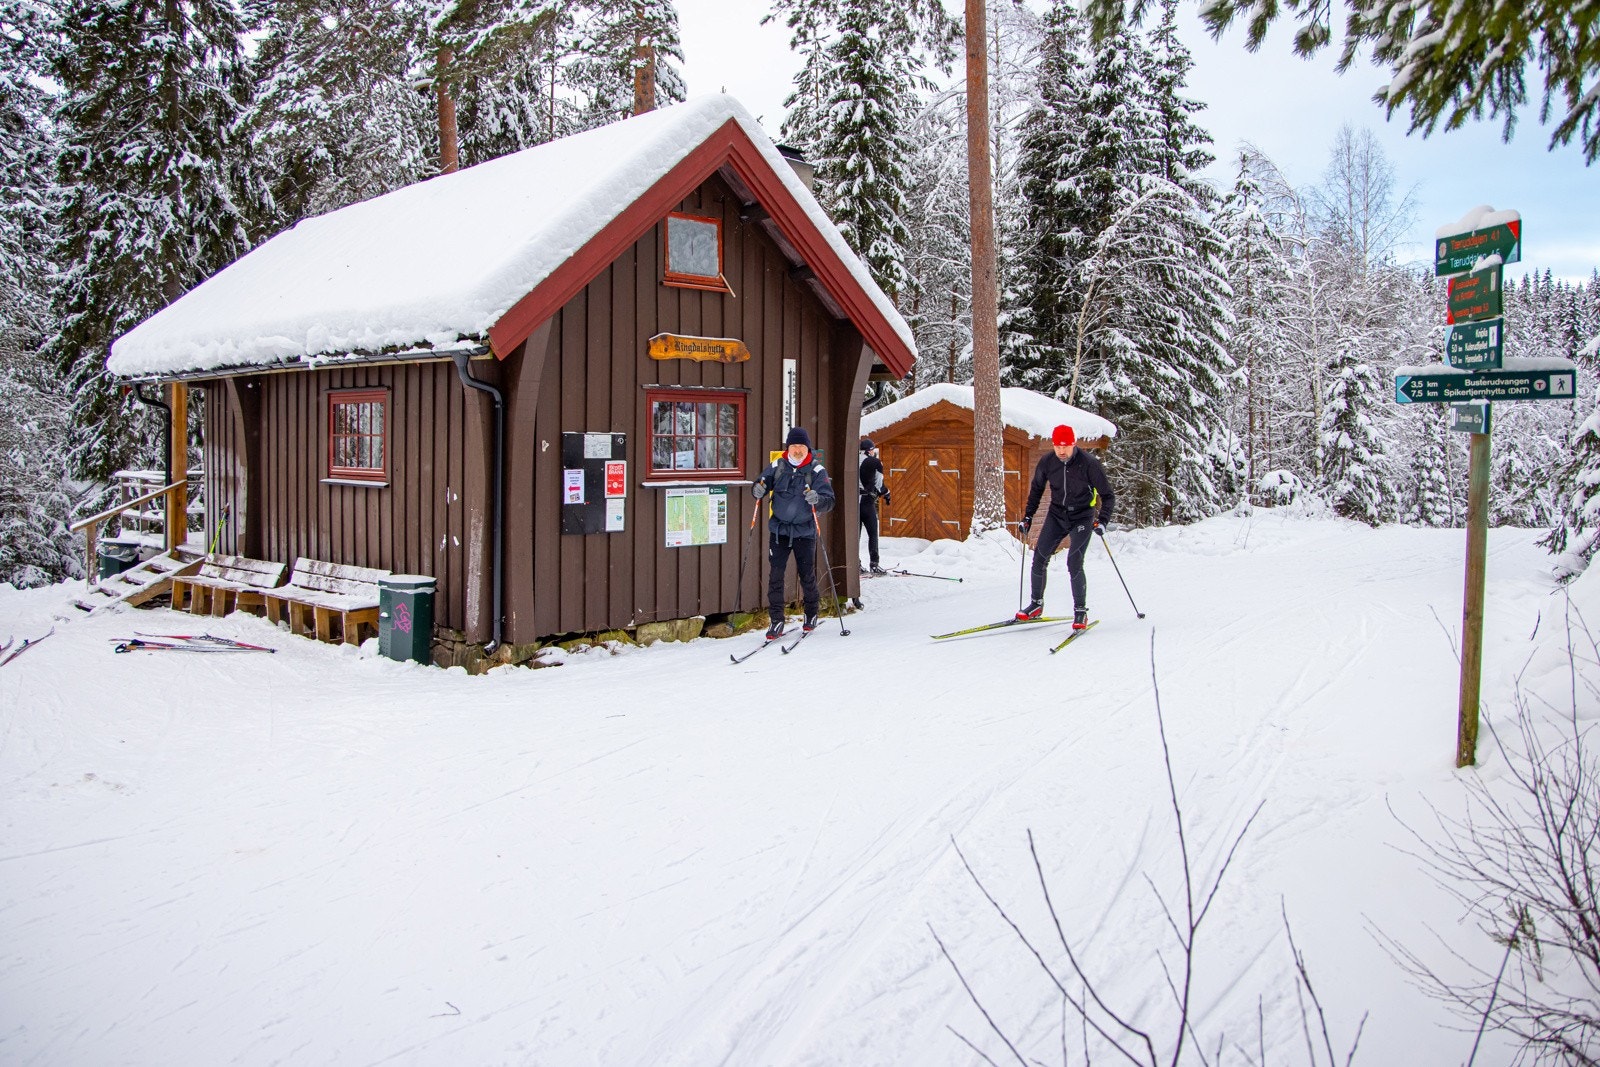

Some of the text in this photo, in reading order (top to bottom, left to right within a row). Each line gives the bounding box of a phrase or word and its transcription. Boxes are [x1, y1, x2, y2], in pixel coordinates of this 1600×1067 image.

[1465, 378, 1529, 387] Busterudvangen
[1444, 388, 1505, 397] Spikertjernhytta
[1508, 387, 1530, 395] (DNT)
